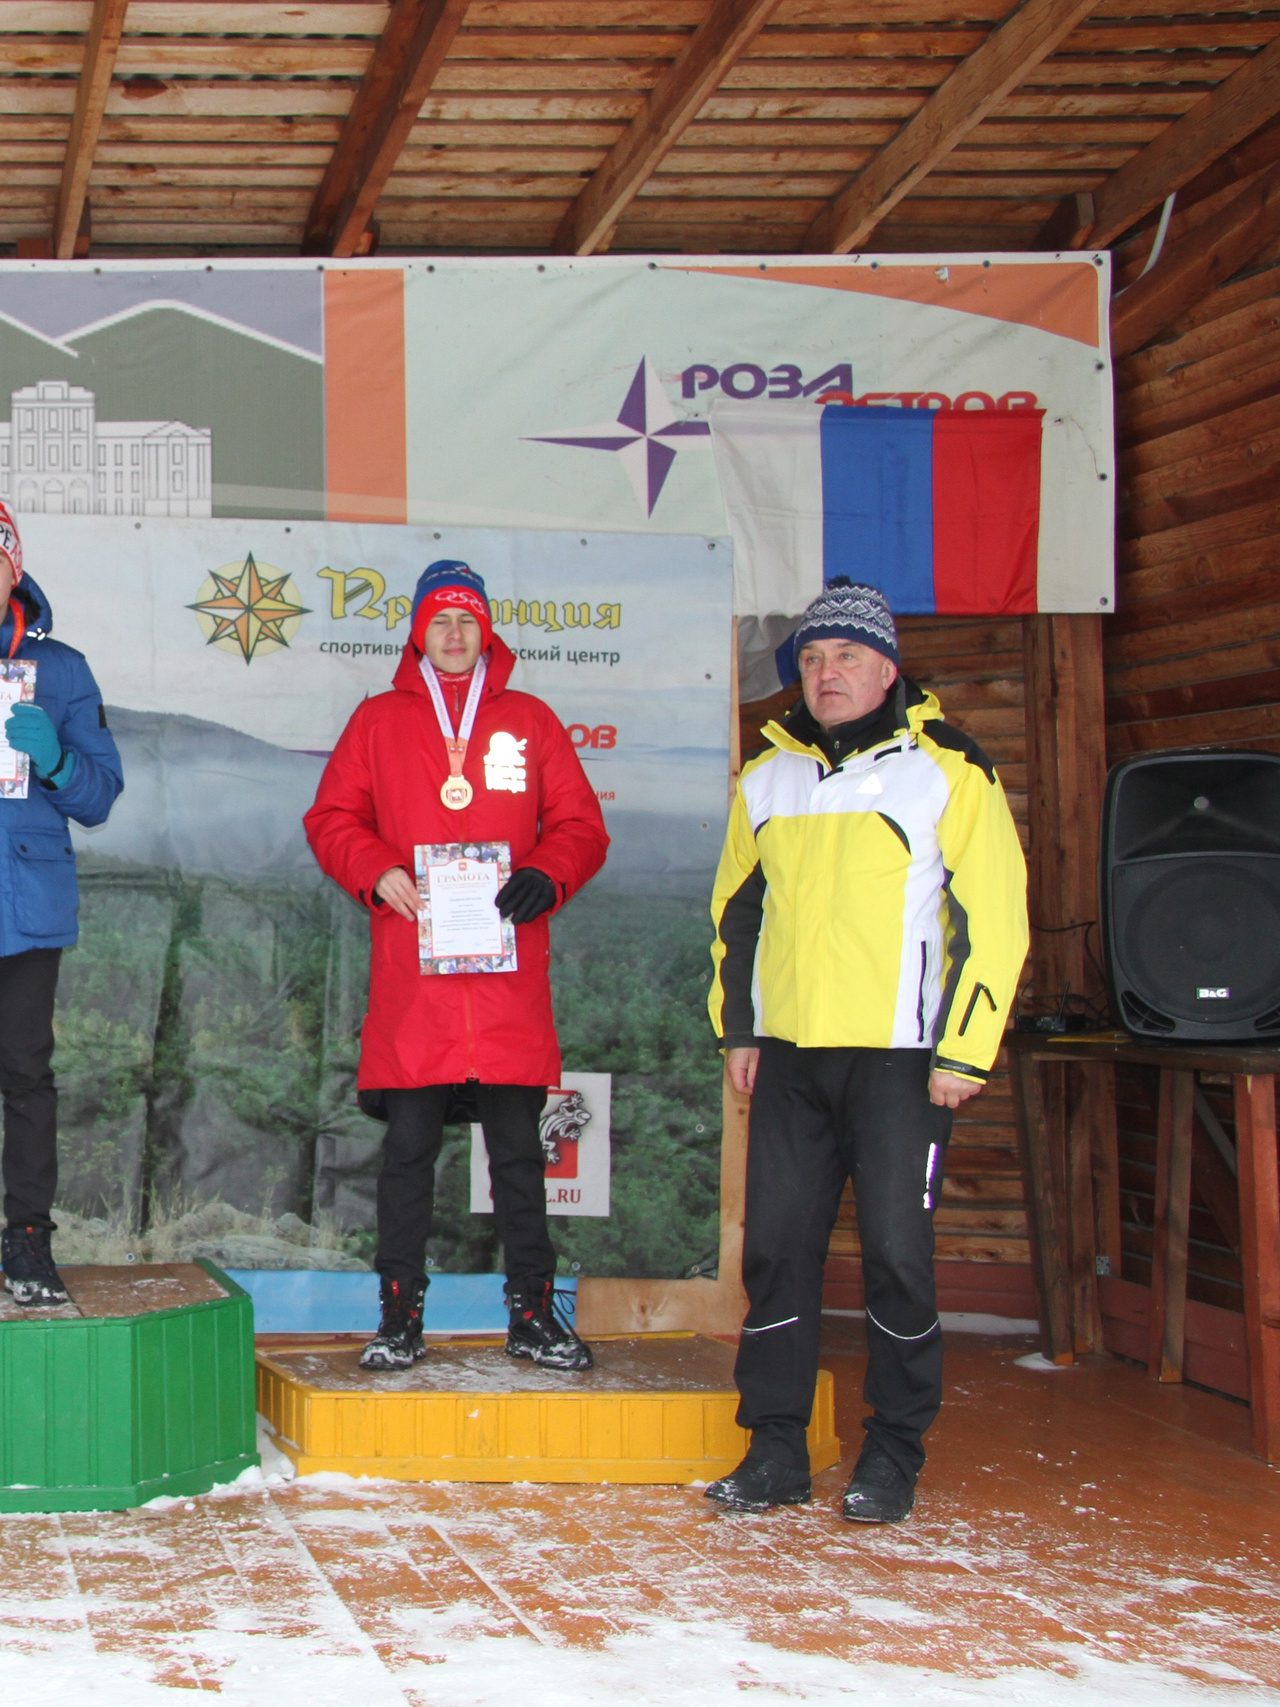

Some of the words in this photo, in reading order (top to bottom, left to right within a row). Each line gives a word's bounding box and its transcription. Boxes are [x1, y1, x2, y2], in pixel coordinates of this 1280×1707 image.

[681, 363, 854, 399] РОЗА
[566, 648, 621, 667] центр
[437, 872, 491, 884] ГРАМОТА
[1198, 988, 1228, 999] B&G
